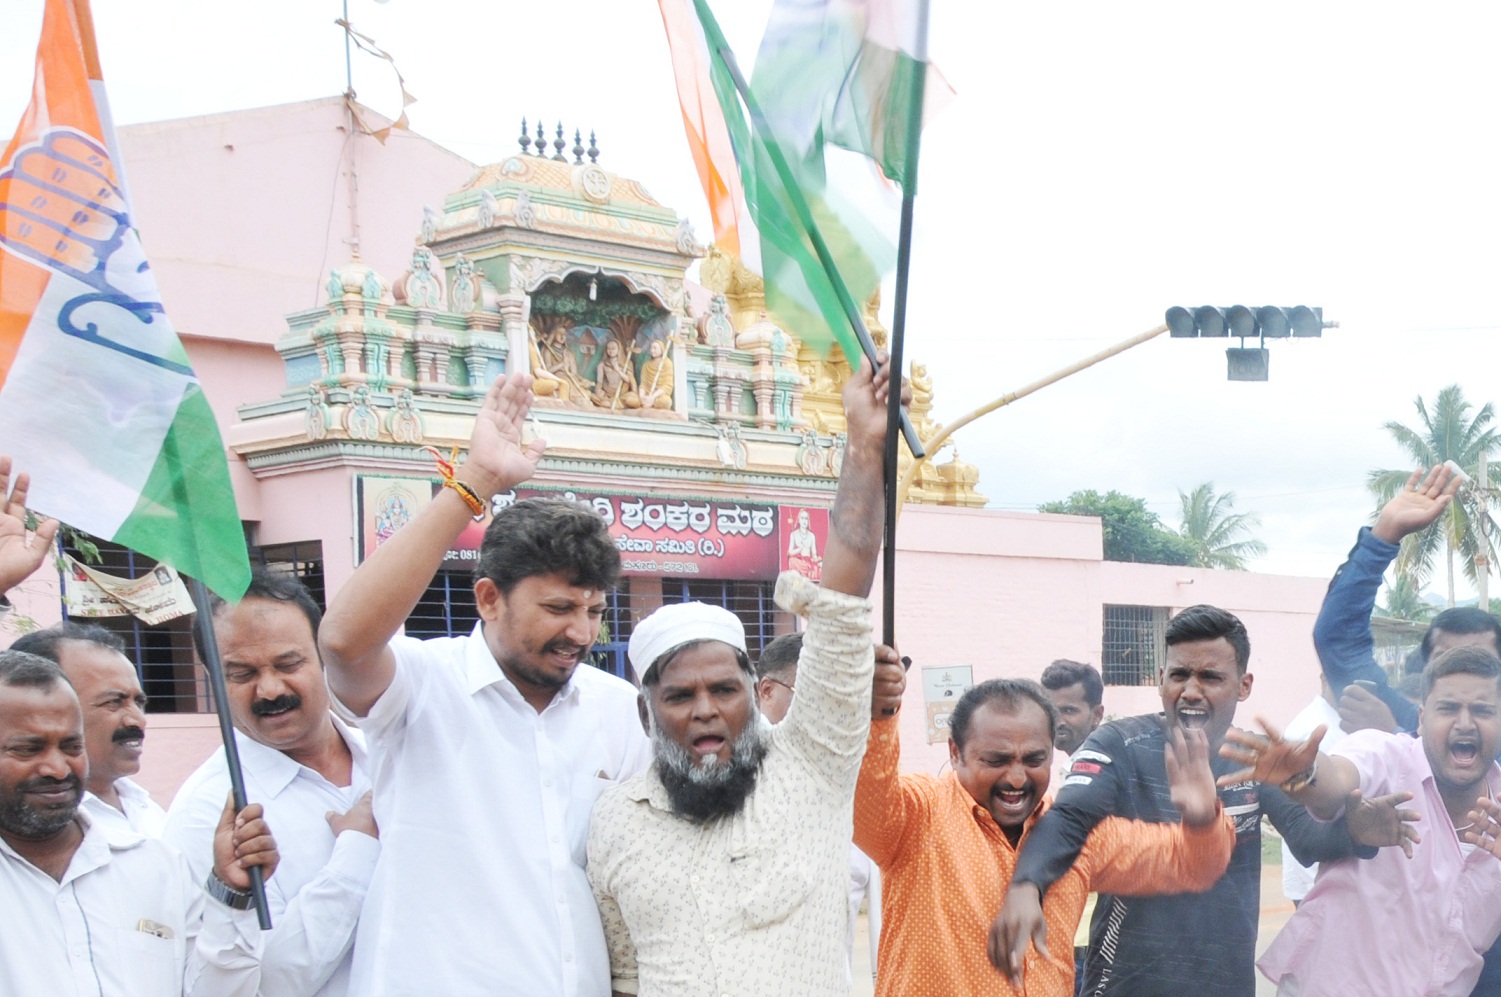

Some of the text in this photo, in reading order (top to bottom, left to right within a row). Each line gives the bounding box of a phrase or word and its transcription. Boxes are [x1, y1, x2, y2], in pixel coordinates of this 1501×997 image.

[620, 498, 711, 534] ಶಂಕರ
[717, 504, 774, 538] ಮಠ
[655, 536, 696, 554] ಸಮಿತಿ
[697, 537, 725, 558] (ರಿ.)
